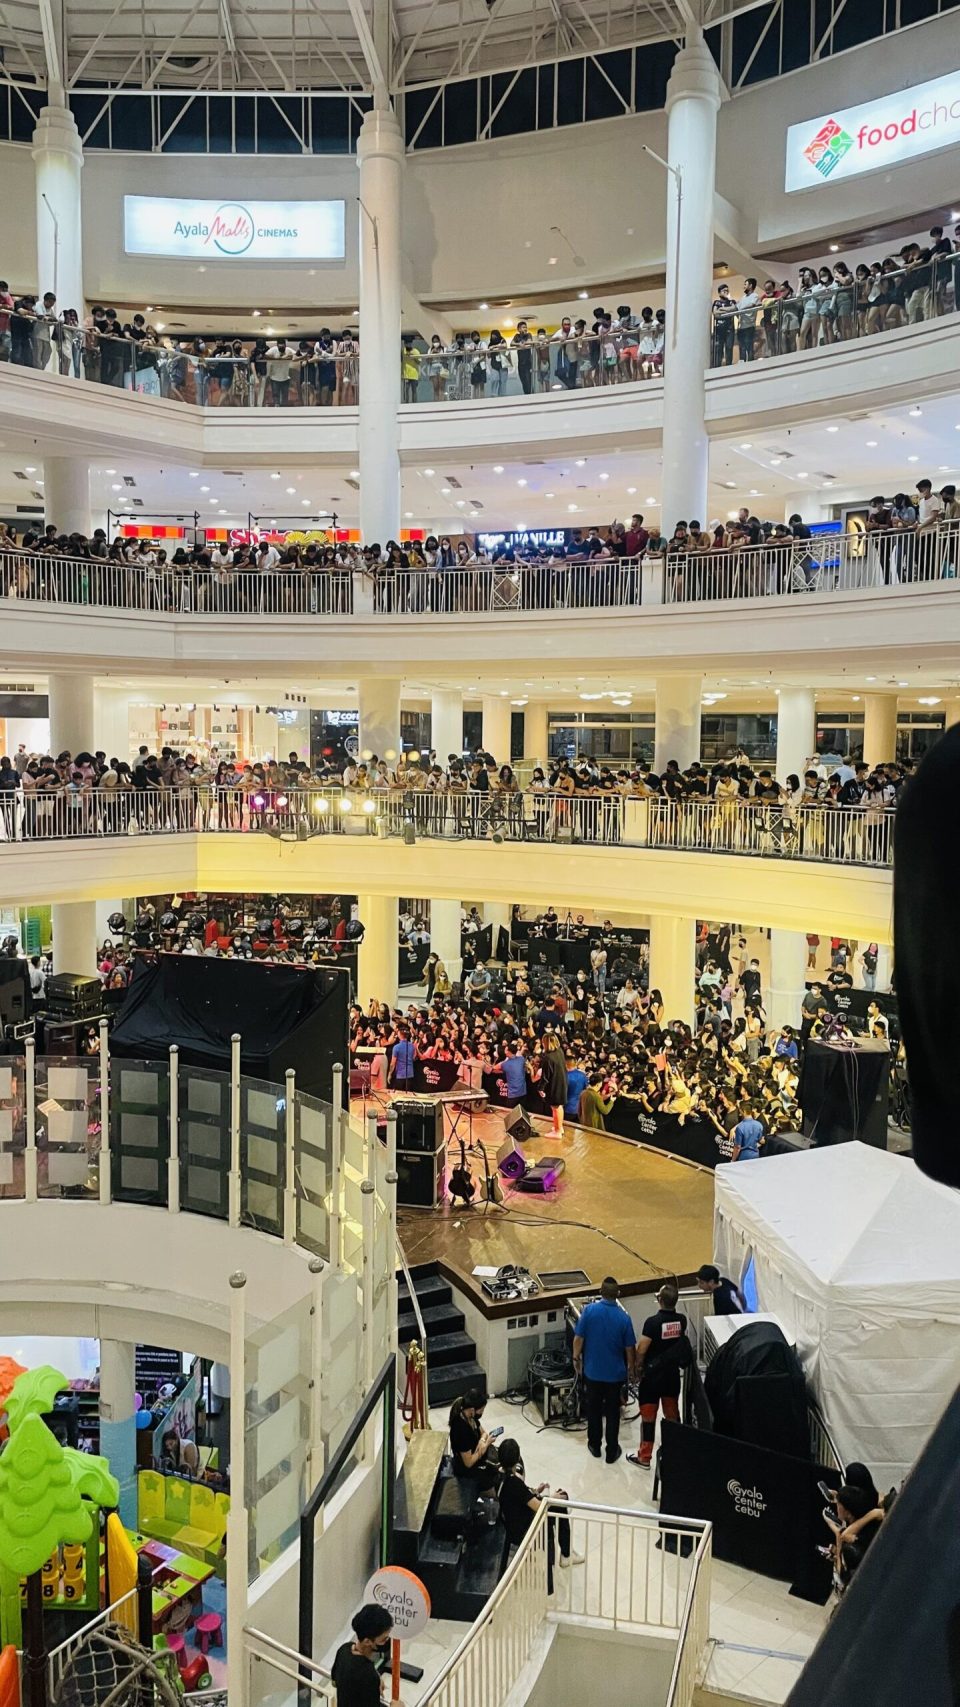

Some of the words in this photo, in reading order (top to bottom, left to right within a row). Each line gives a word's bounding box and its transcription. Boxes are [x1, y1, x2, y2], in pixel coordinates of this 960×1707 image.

[173, 221, 209, 239] Ayala
[204, 216, 250, 245] Malls
[257, 228, 299, 238] CINEMAS
[732, 1485, 763, 1500] ayala
[734, 1496, 767, 1511] center
[734, 1504, 760, 1518] cebu
[43, 1584, 54, 1597] 8
[64, 1585, 75, 1598] 9
[380, 1591, 414, 1607] ayala
[394, 1615, 409, 1627] bu
